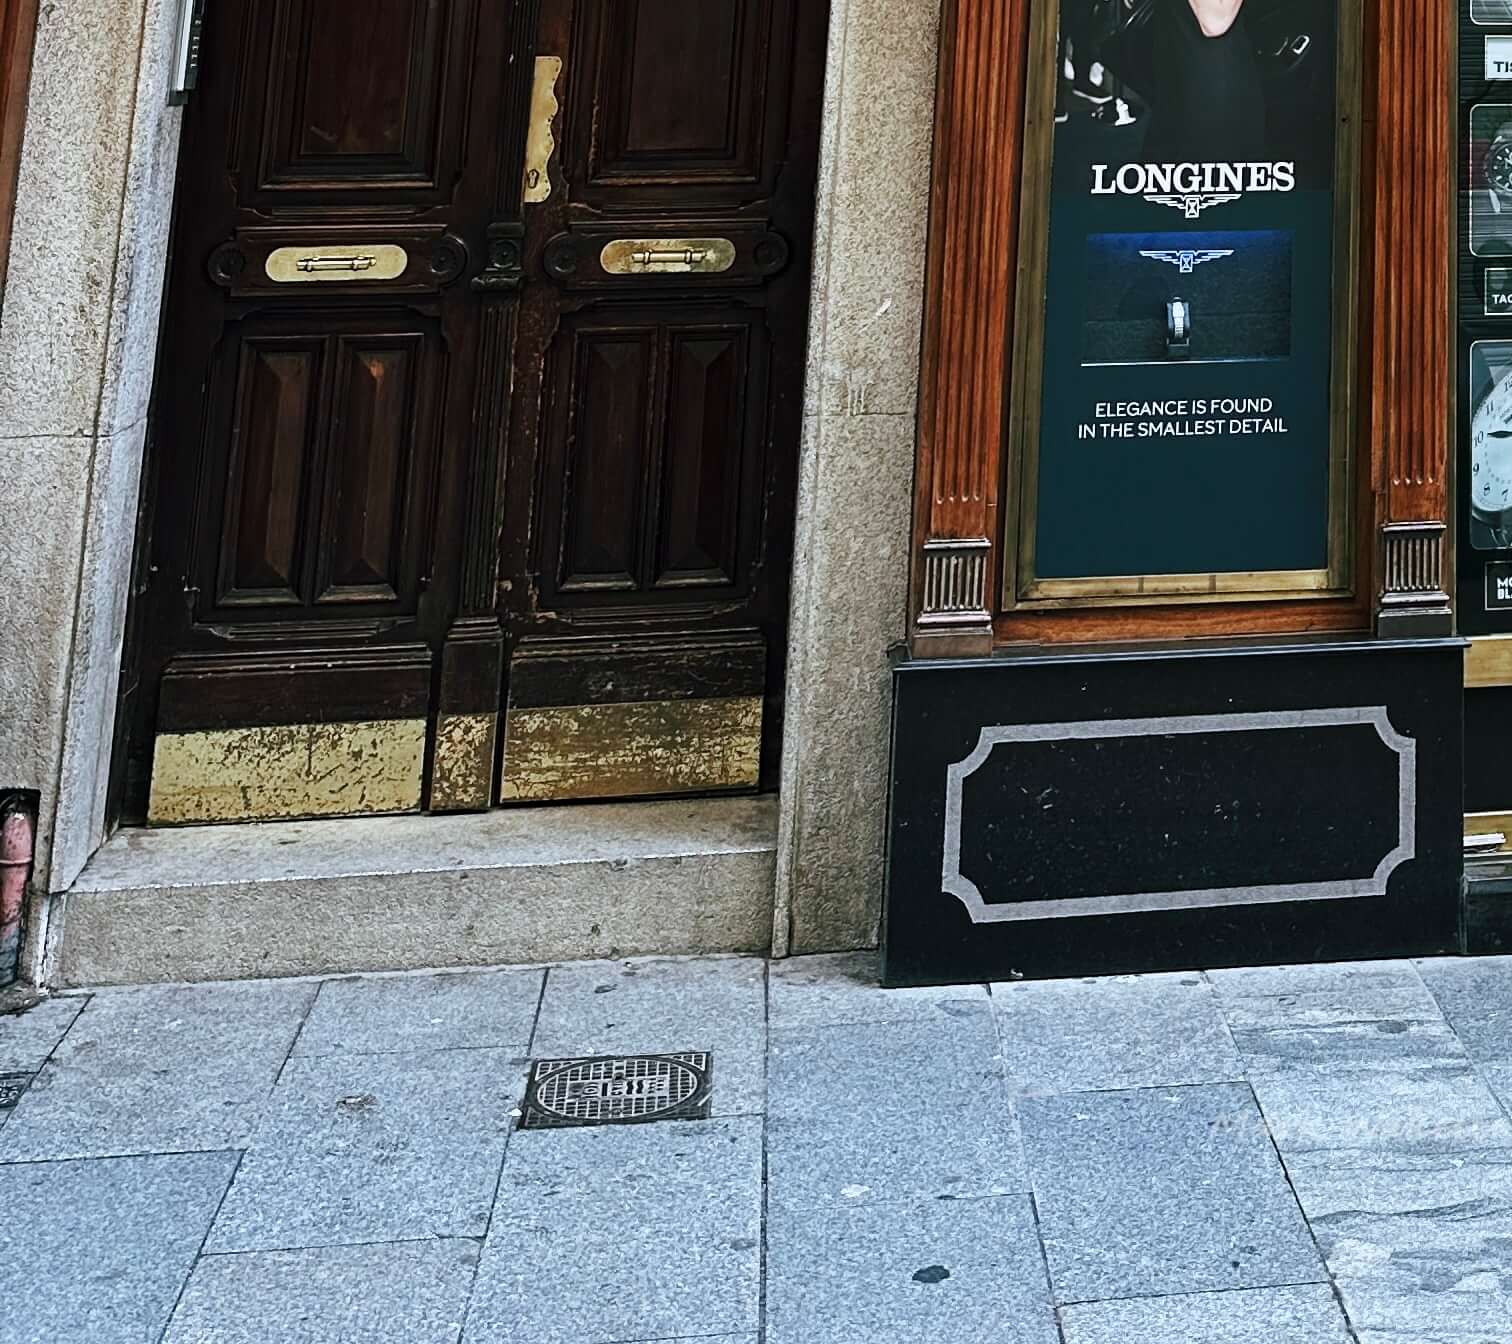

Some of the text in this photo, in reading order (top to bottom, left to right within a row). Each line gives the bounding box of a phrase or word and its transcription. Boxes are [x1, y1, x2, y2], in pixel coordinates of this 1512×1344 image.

[1090, 162, 1295, 195] LONGINES
[1095, 397, 1273, 419] ELEGANCE IS FOUND
[1078, 417, 1288, 439] IN THE SMALLEST DETAIL
